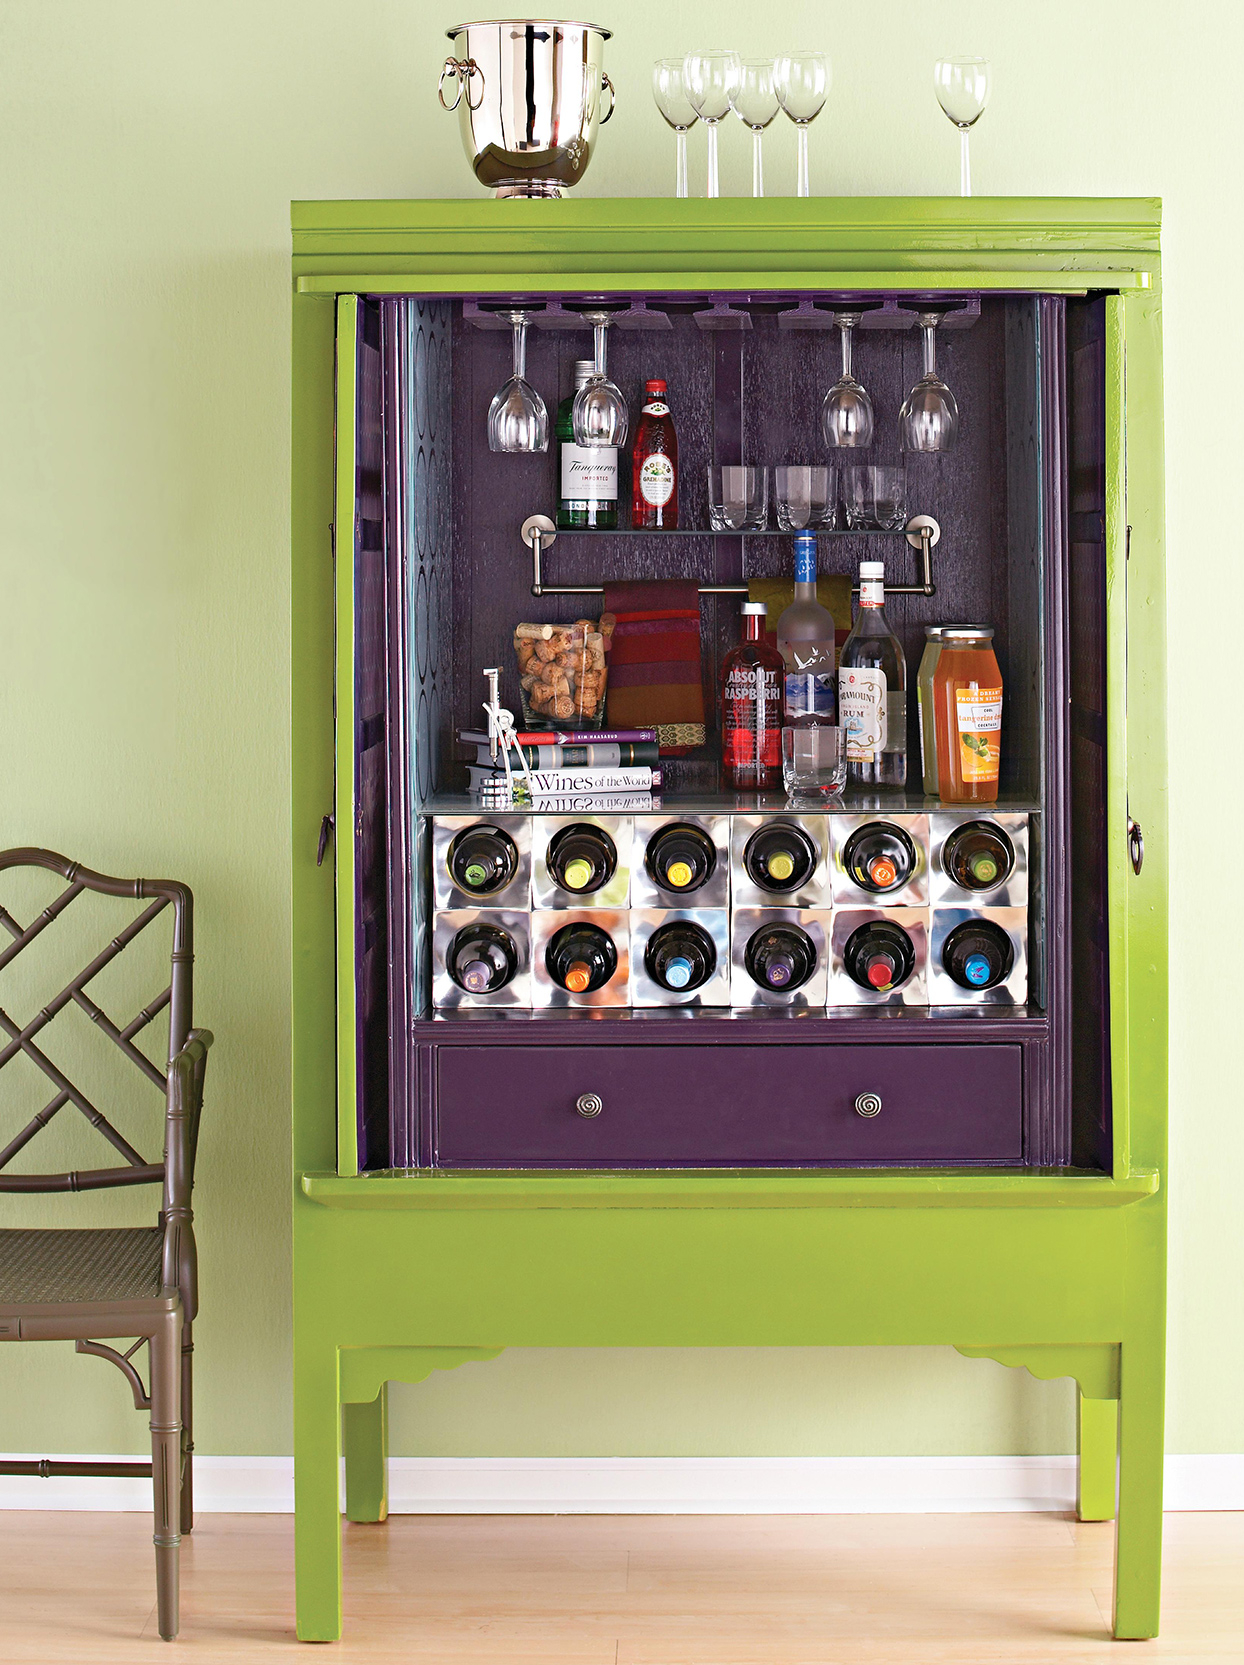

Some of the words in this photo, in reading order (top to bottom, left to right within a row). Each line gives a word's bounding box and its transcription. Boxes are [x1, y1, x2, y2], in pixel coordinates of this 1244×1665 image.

[569, 460, 616, 475] Tanqueray
[644, 462, 671, 474] ROSE'S
[728, 671, 777, 683] ABSOLUT
[725, 688, 780, 700] RASPBERRI
[959, 714, 993, 723] tangerine
[534, 773, 593, 791] Wines
[595, 776, 606, 787] of
[606, 775, 622, 787] the
[622, 773, 650, 786] World
